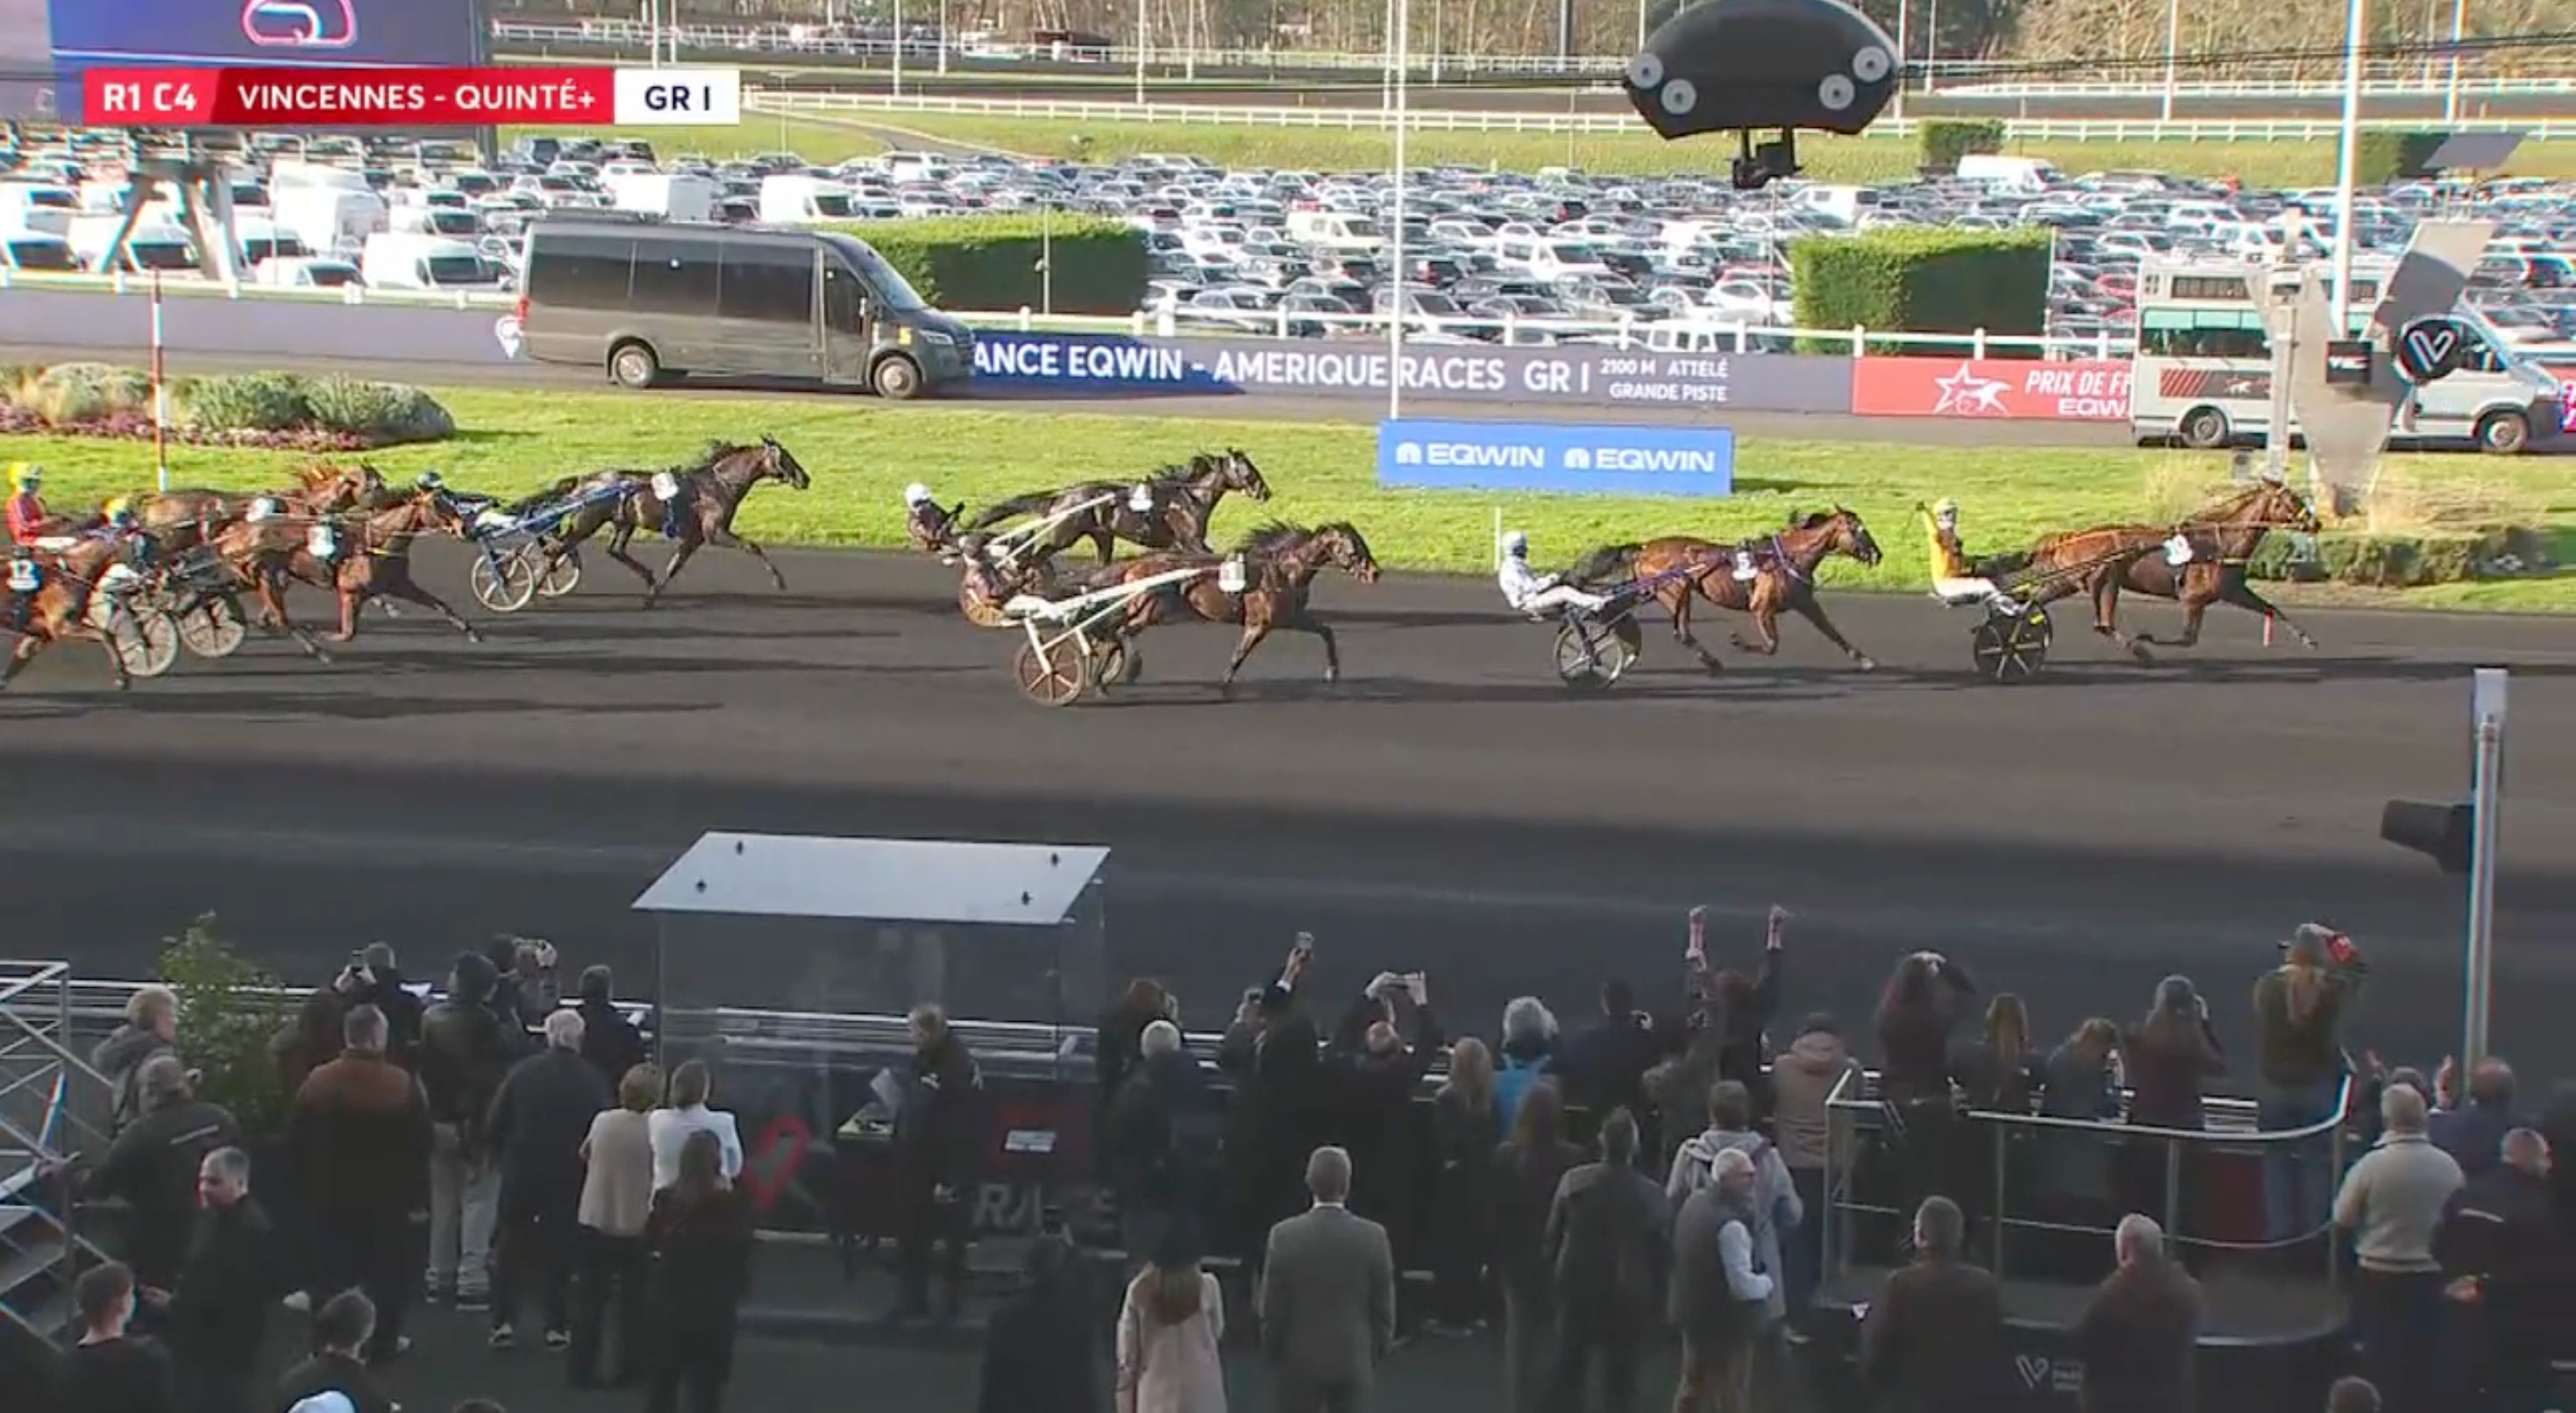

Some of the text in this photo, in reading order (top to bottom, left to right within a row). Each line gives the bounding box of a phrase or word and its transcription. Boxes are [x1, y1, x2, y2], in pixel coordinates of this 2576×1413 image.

[1067, 344, 1184, 380] EQWIN
[1213, 350, 1390, 387] AMERIQUE
[1398, 355, 1506, 391] RACES
[1523, 359, 1571, 393] GR
[1581, 361, 1590, 393] I
[1598, 357, 1638, 375] 2100
[1608, 382, 1730, 402] GRANDE PISTE
[2025, 369, 2076, 395] PRIX
[2077, 370, 2105, 395] DE
[1427, 443, 1545, 468] EQWIN
[1595, 447, 1715, 472] EQWIN
